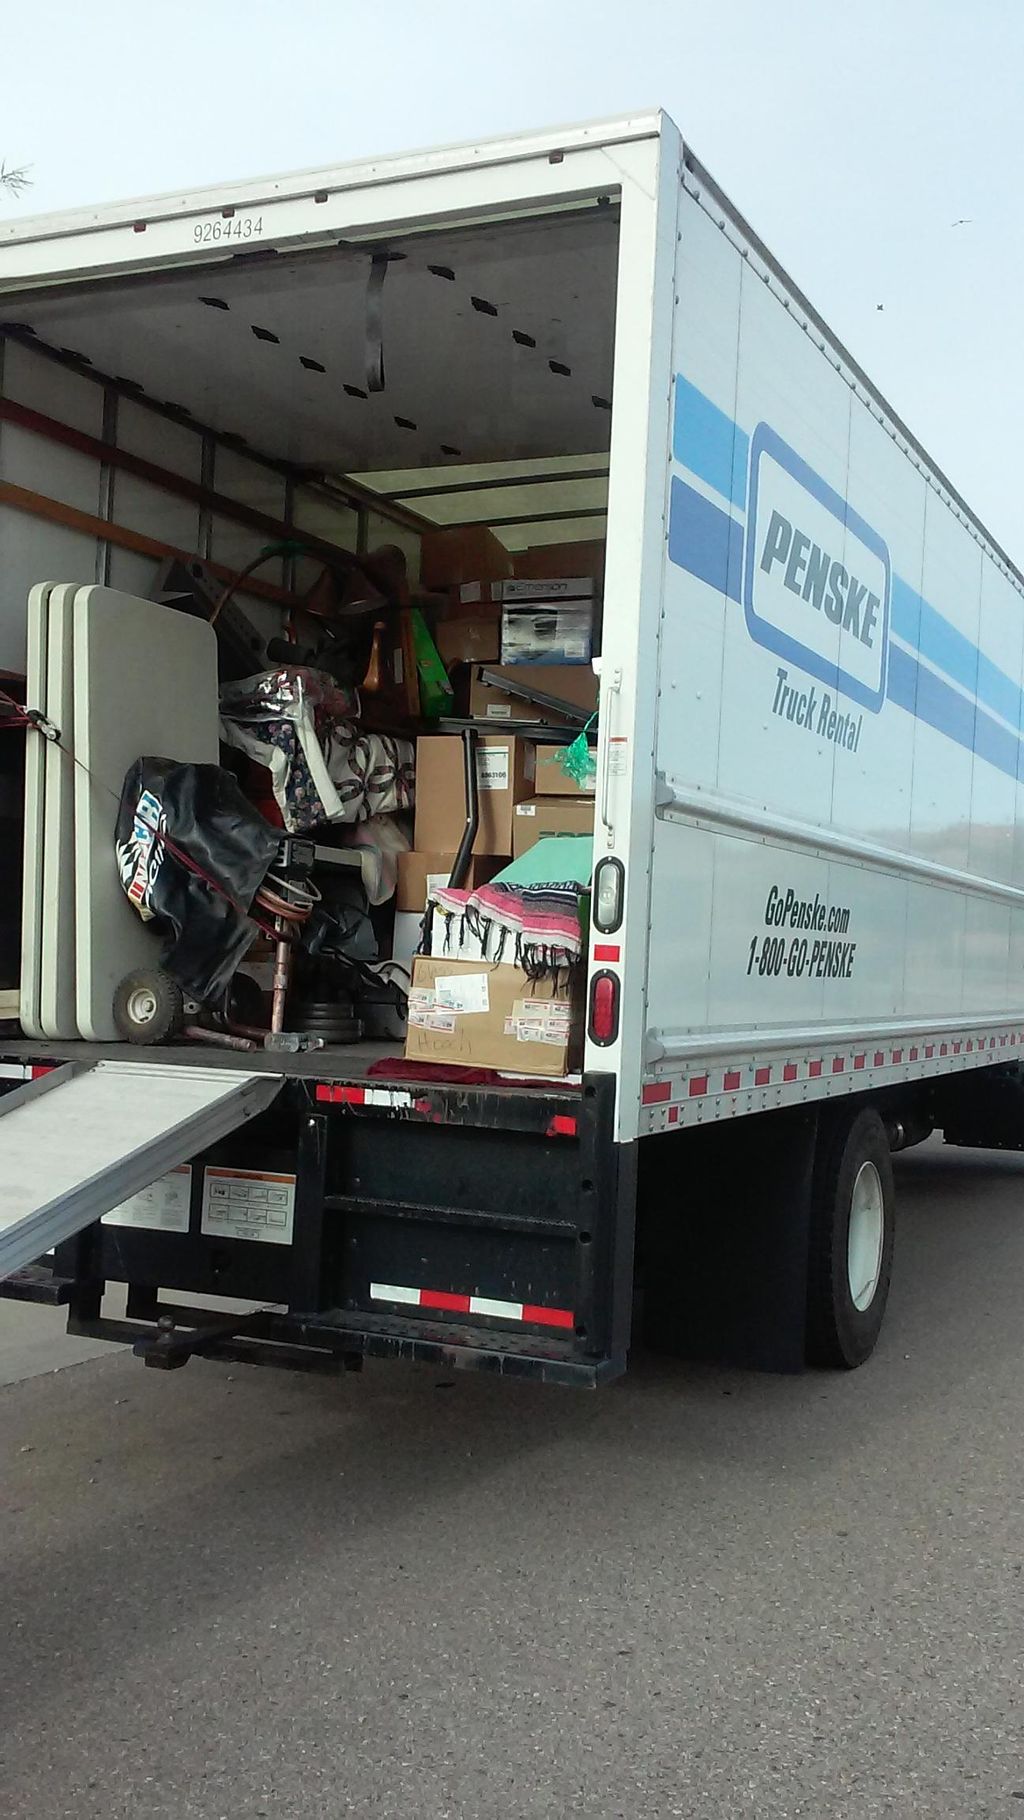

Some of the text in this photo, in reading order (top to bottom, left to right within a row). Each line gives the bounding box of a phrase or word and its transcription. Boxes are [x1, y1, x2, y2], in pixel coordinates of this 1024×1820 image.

[193, 217, 263, 243] 9264434
[760, 509, 880, 649] PENSKE
[772, 667, 863, 753] Truck Rental
[765, 885, 850, 933] GoPenske.com
[747, 936, 856, 977] 1-800-GO-PENSKE
